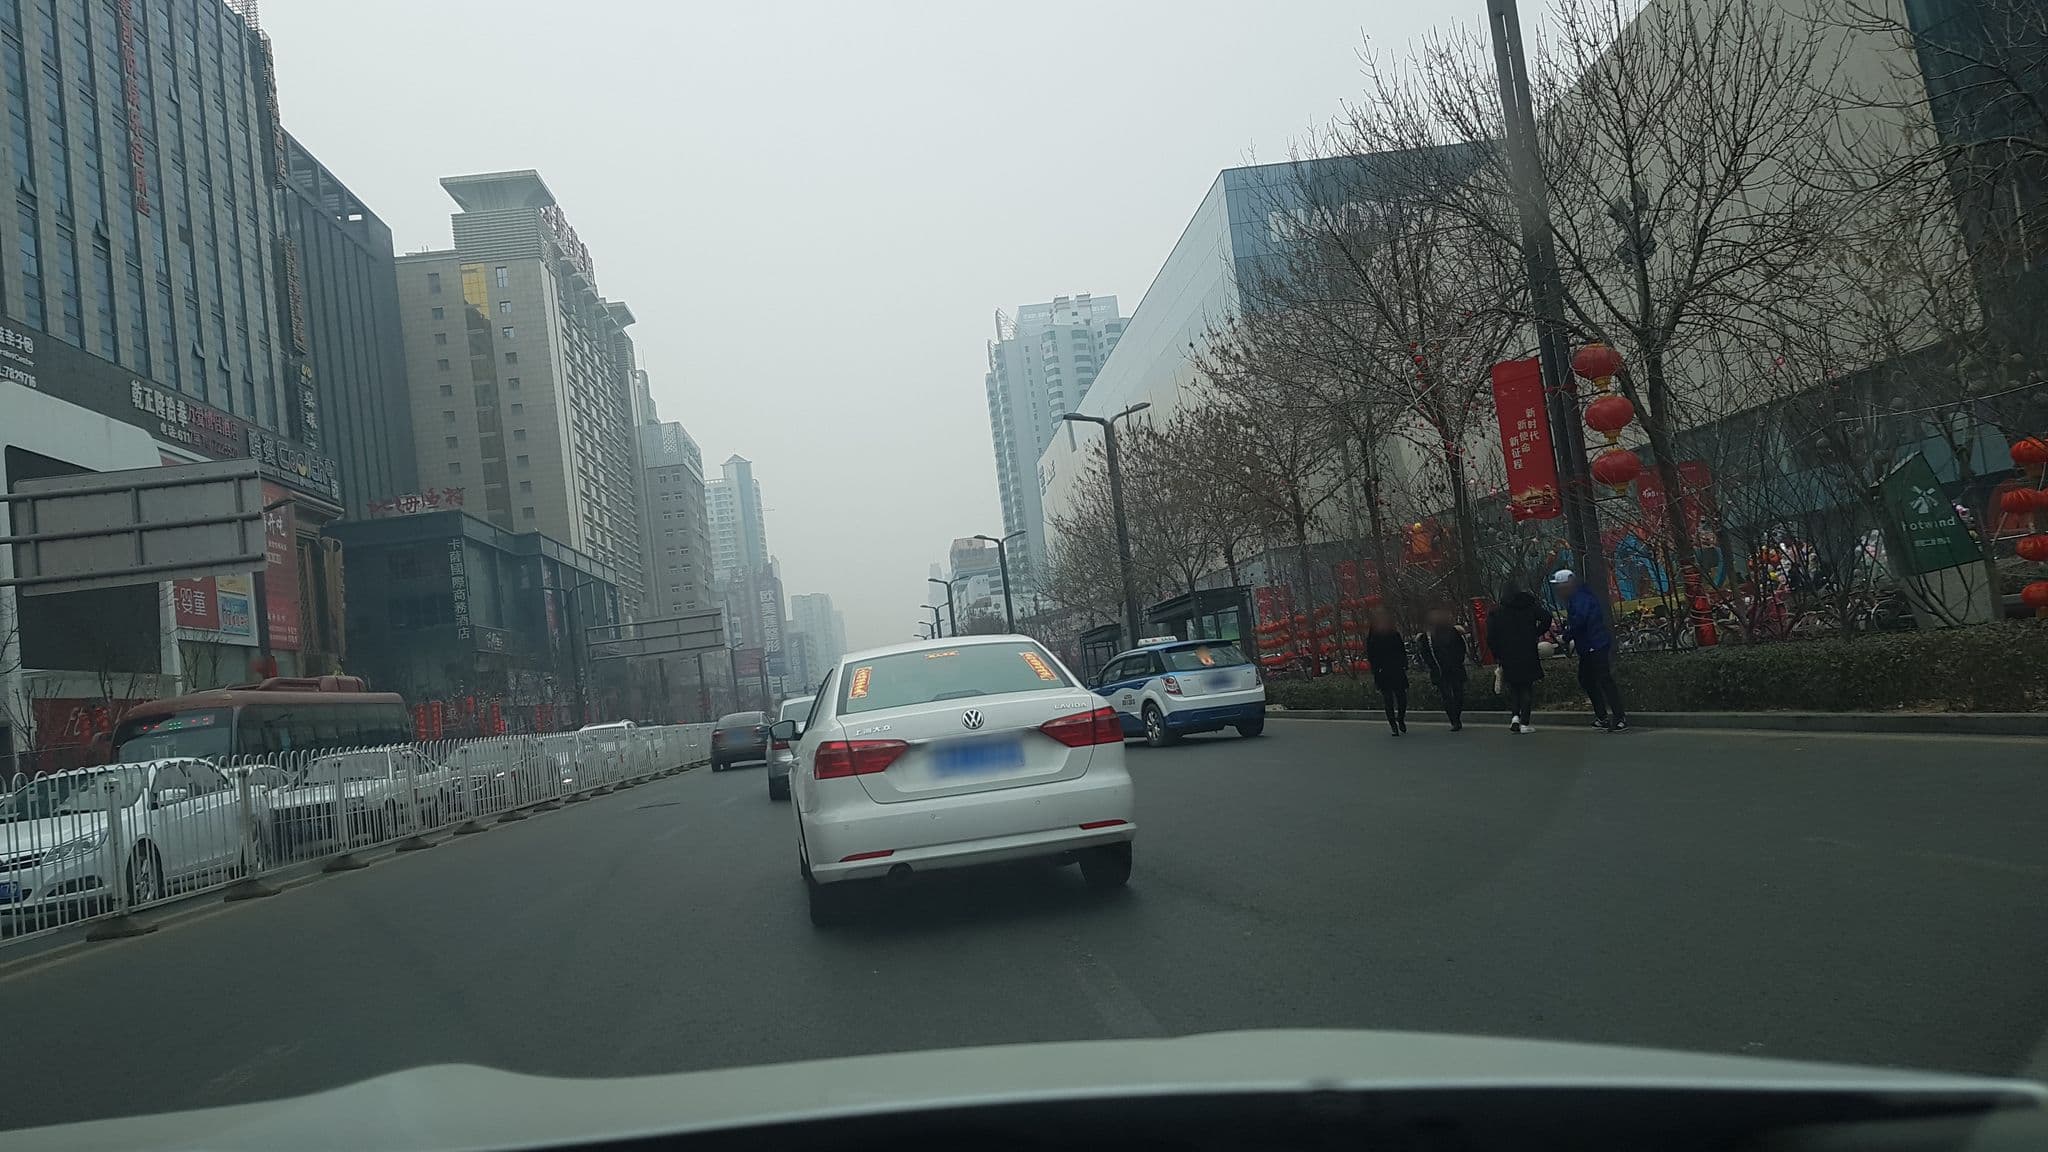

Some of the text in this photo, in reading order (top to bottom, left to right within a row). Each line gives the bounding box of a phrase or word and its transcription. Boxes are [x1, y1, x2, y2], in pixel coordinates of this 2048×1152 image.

[1517, 420, 1531, 453] 新使命
[1526, 408, 1541, 442] 新时代
[1509, 435, 1524, 470] 新征程
[1054, 702, 1088, 710] LAVIDA
